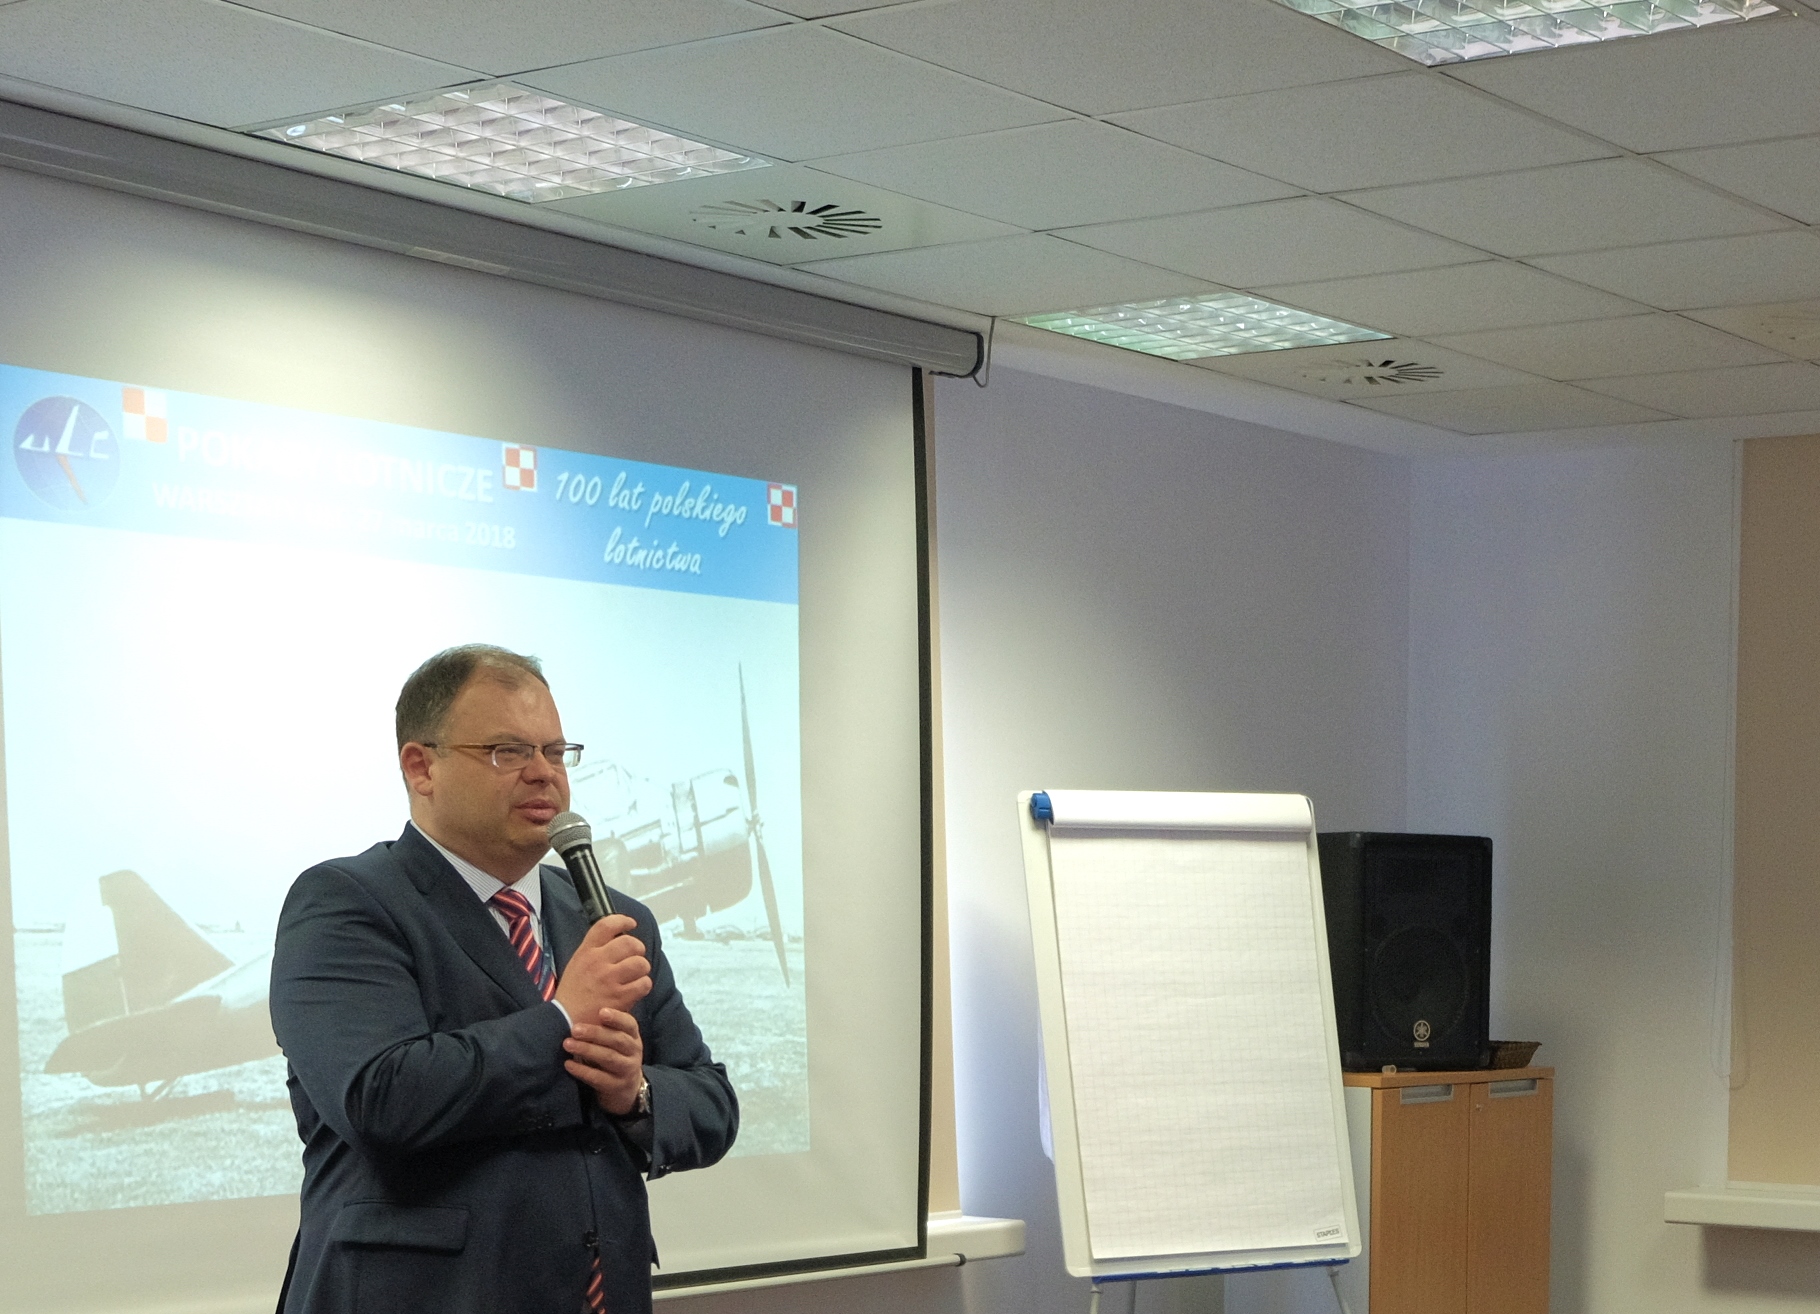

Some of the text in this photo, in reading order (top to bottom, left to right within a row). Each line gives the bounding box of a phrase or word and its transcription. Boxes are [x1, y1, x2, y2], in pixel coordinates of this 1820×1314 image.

[555, 470, 748, 538] 100 lat polskiego
[465, 520, 517, 550] 2018
[603, 525, 702, 575] lotnictwa
